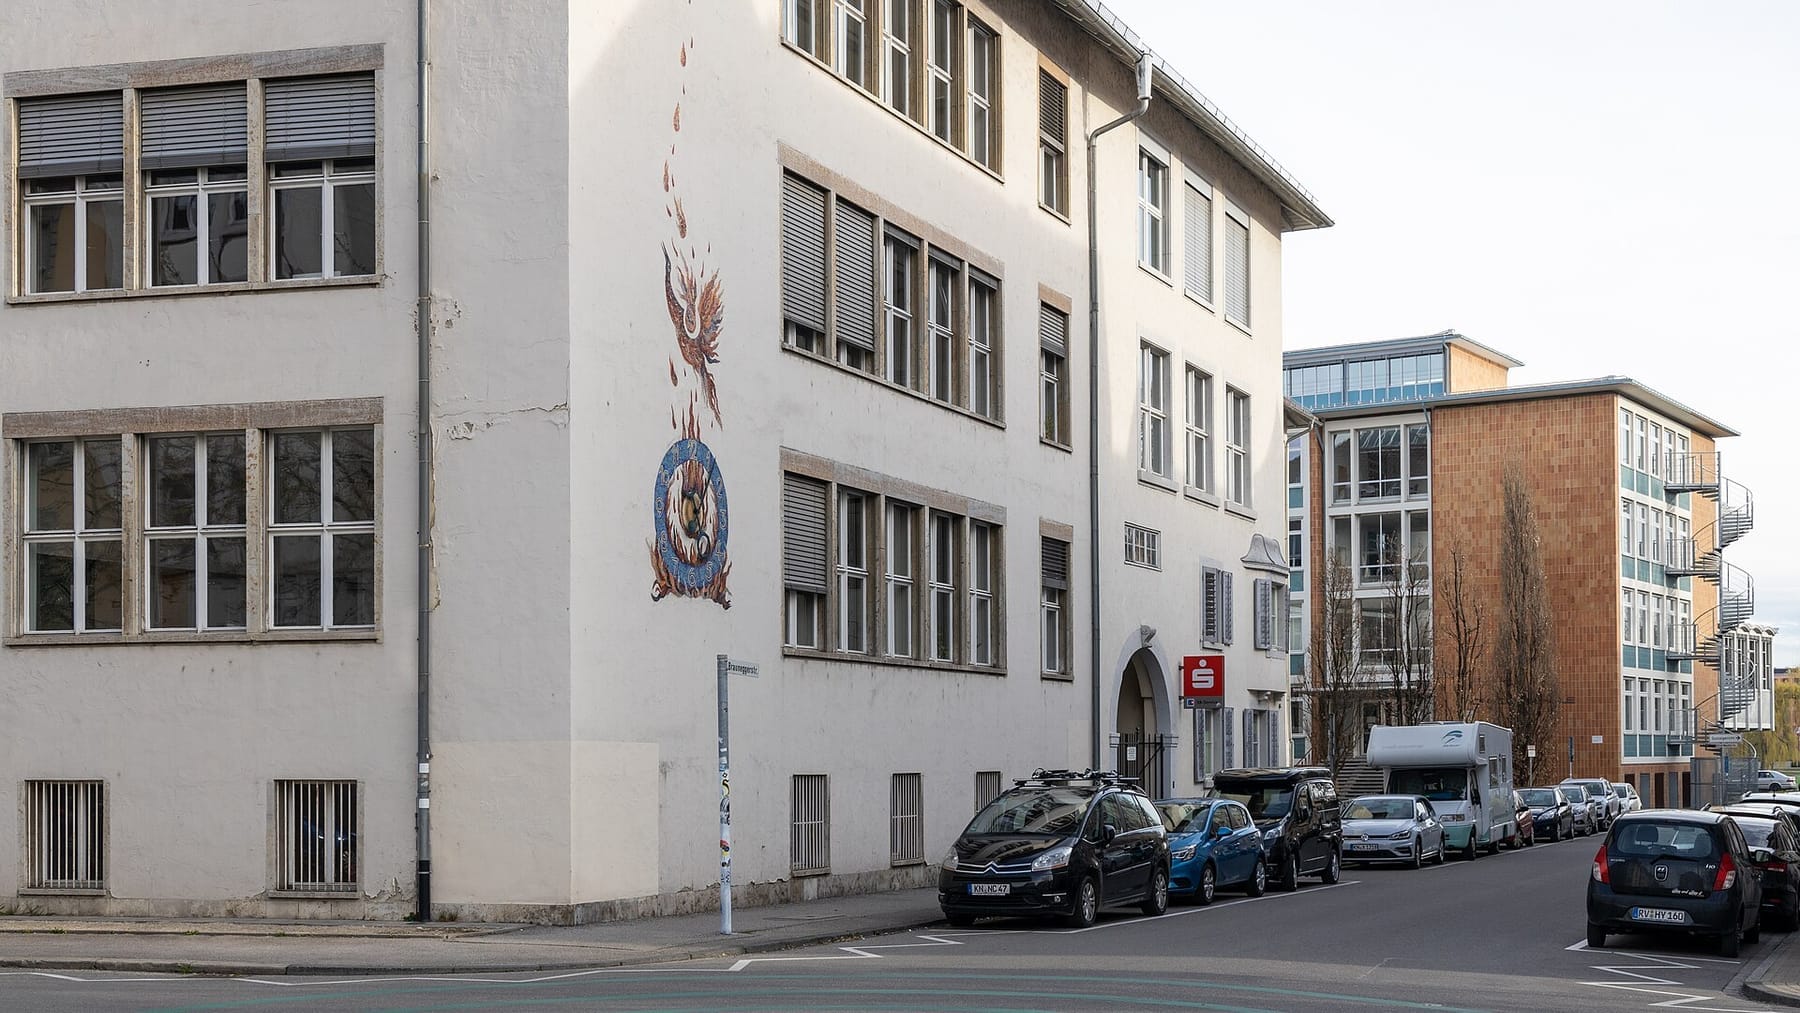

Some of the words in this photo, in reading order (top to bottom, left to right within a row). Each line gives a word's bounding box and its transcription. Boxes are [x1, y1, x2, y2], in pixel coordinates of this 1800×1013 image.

[687, 567, 696, 587] 6
[1654, 911, 1666, 919] HY
[1667, 911, 1684, 921] 160
